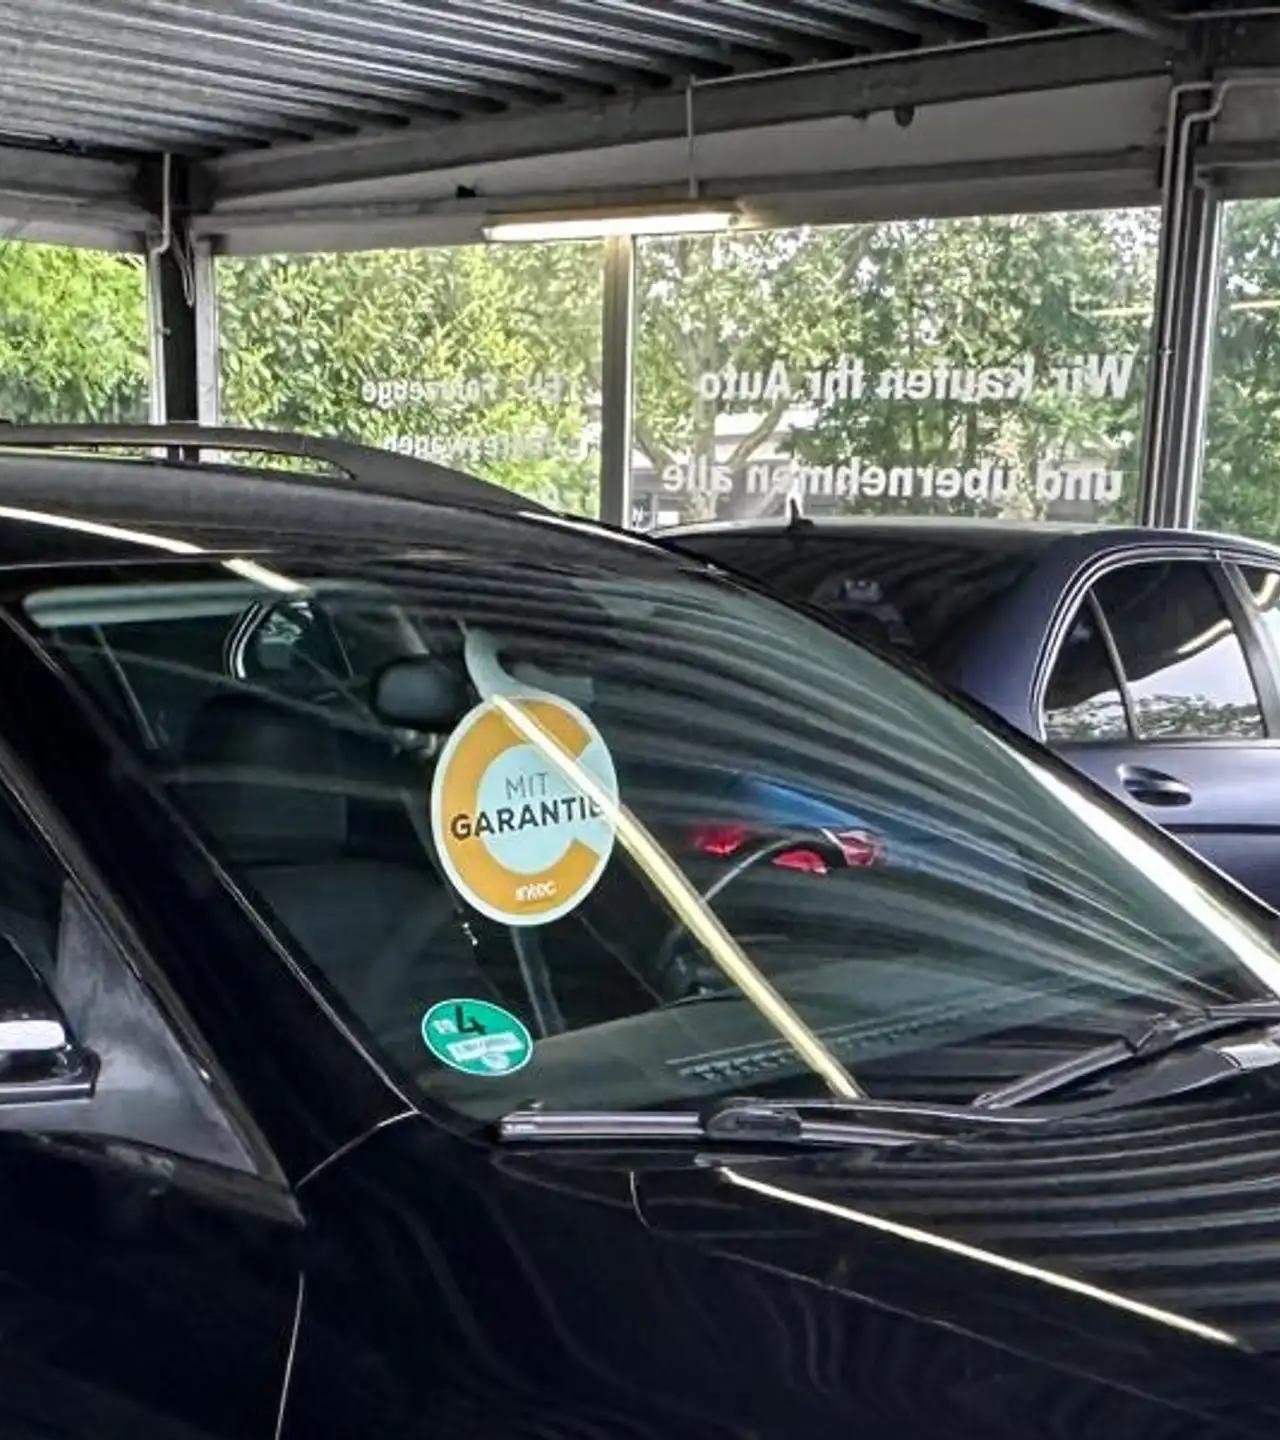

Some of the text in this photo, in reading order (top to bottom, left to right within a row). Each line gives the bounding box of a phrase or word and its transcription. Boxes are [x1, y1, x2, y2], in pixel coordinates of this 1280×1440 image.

[504, 772, 549, 801] MIT
[450, 796, 607, 841] GARANTIE
[455, 1004, 487, 1036] 4
